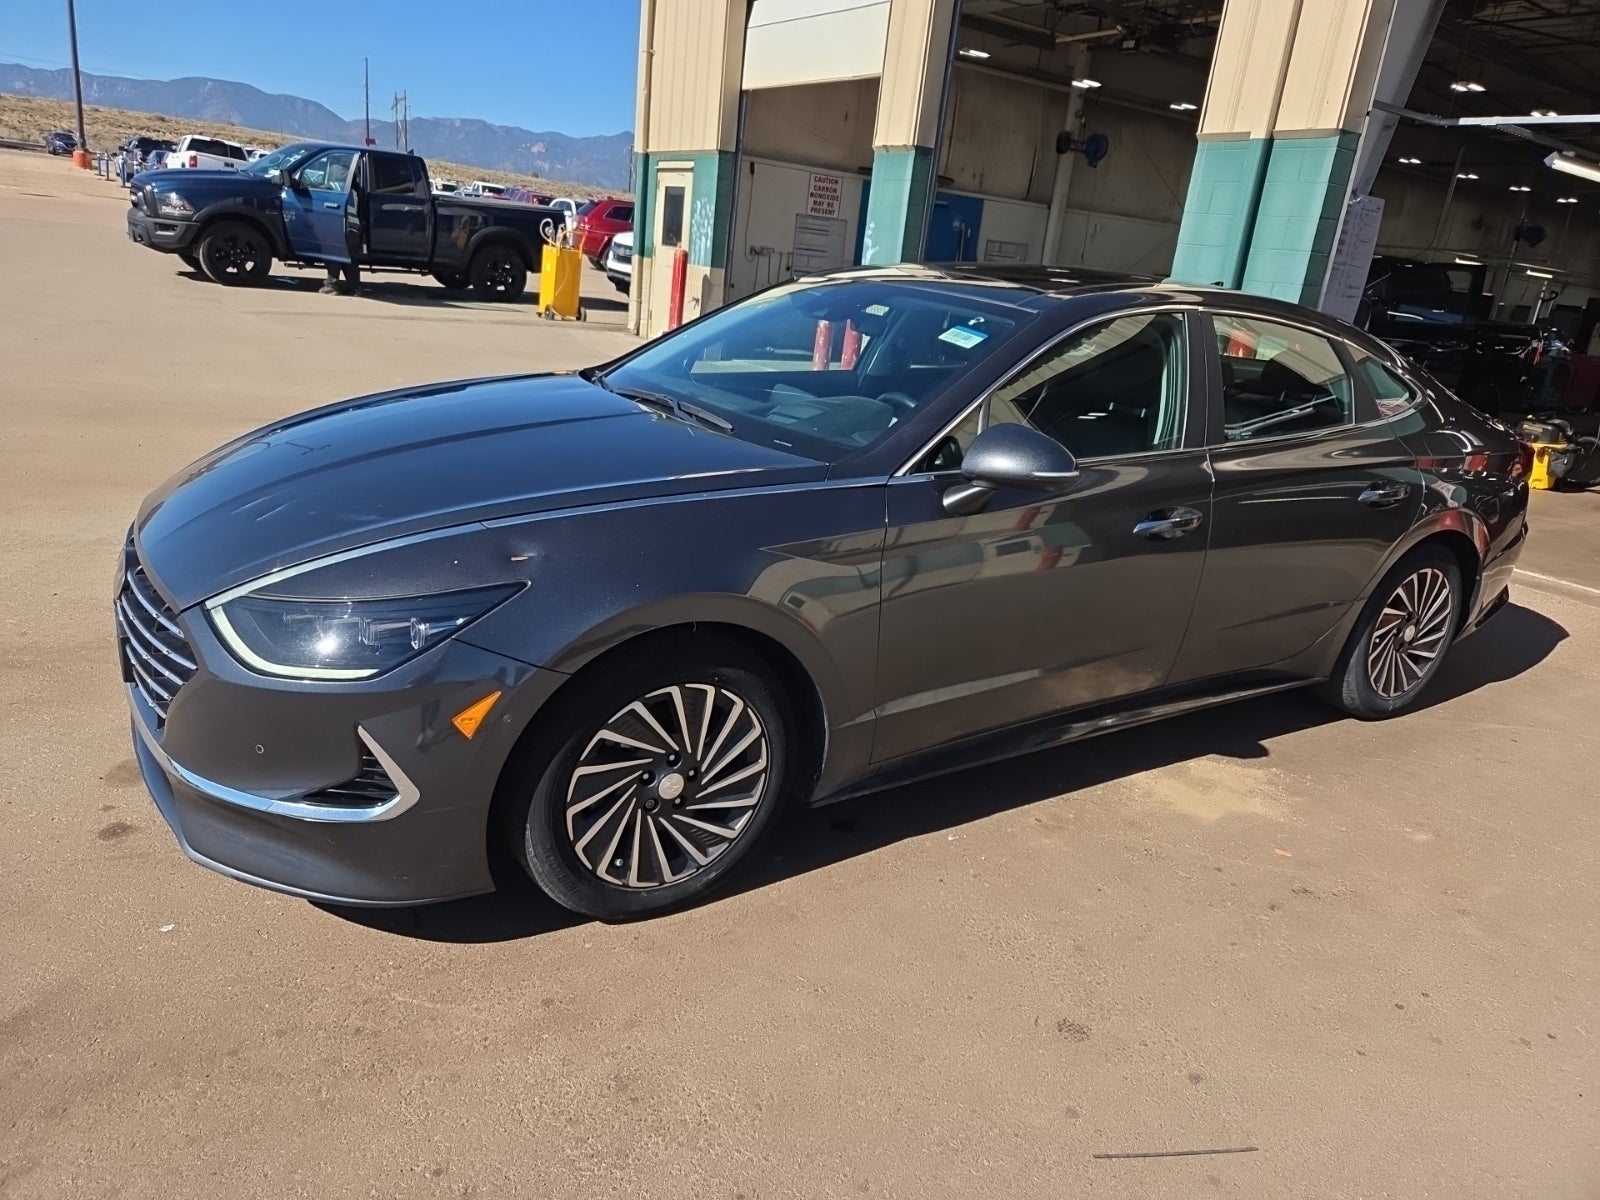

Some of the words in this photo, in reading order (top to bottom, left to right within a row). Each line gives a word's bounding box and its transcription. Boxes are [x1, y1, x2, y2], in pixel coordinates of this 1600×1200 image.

[814, 176, 838, 185] CAUTION
[814, 185, 837, 194] CARBON
[810, 192, 840, 202] MONOXIDE
[810, 207, 835, 215] PRESENT
